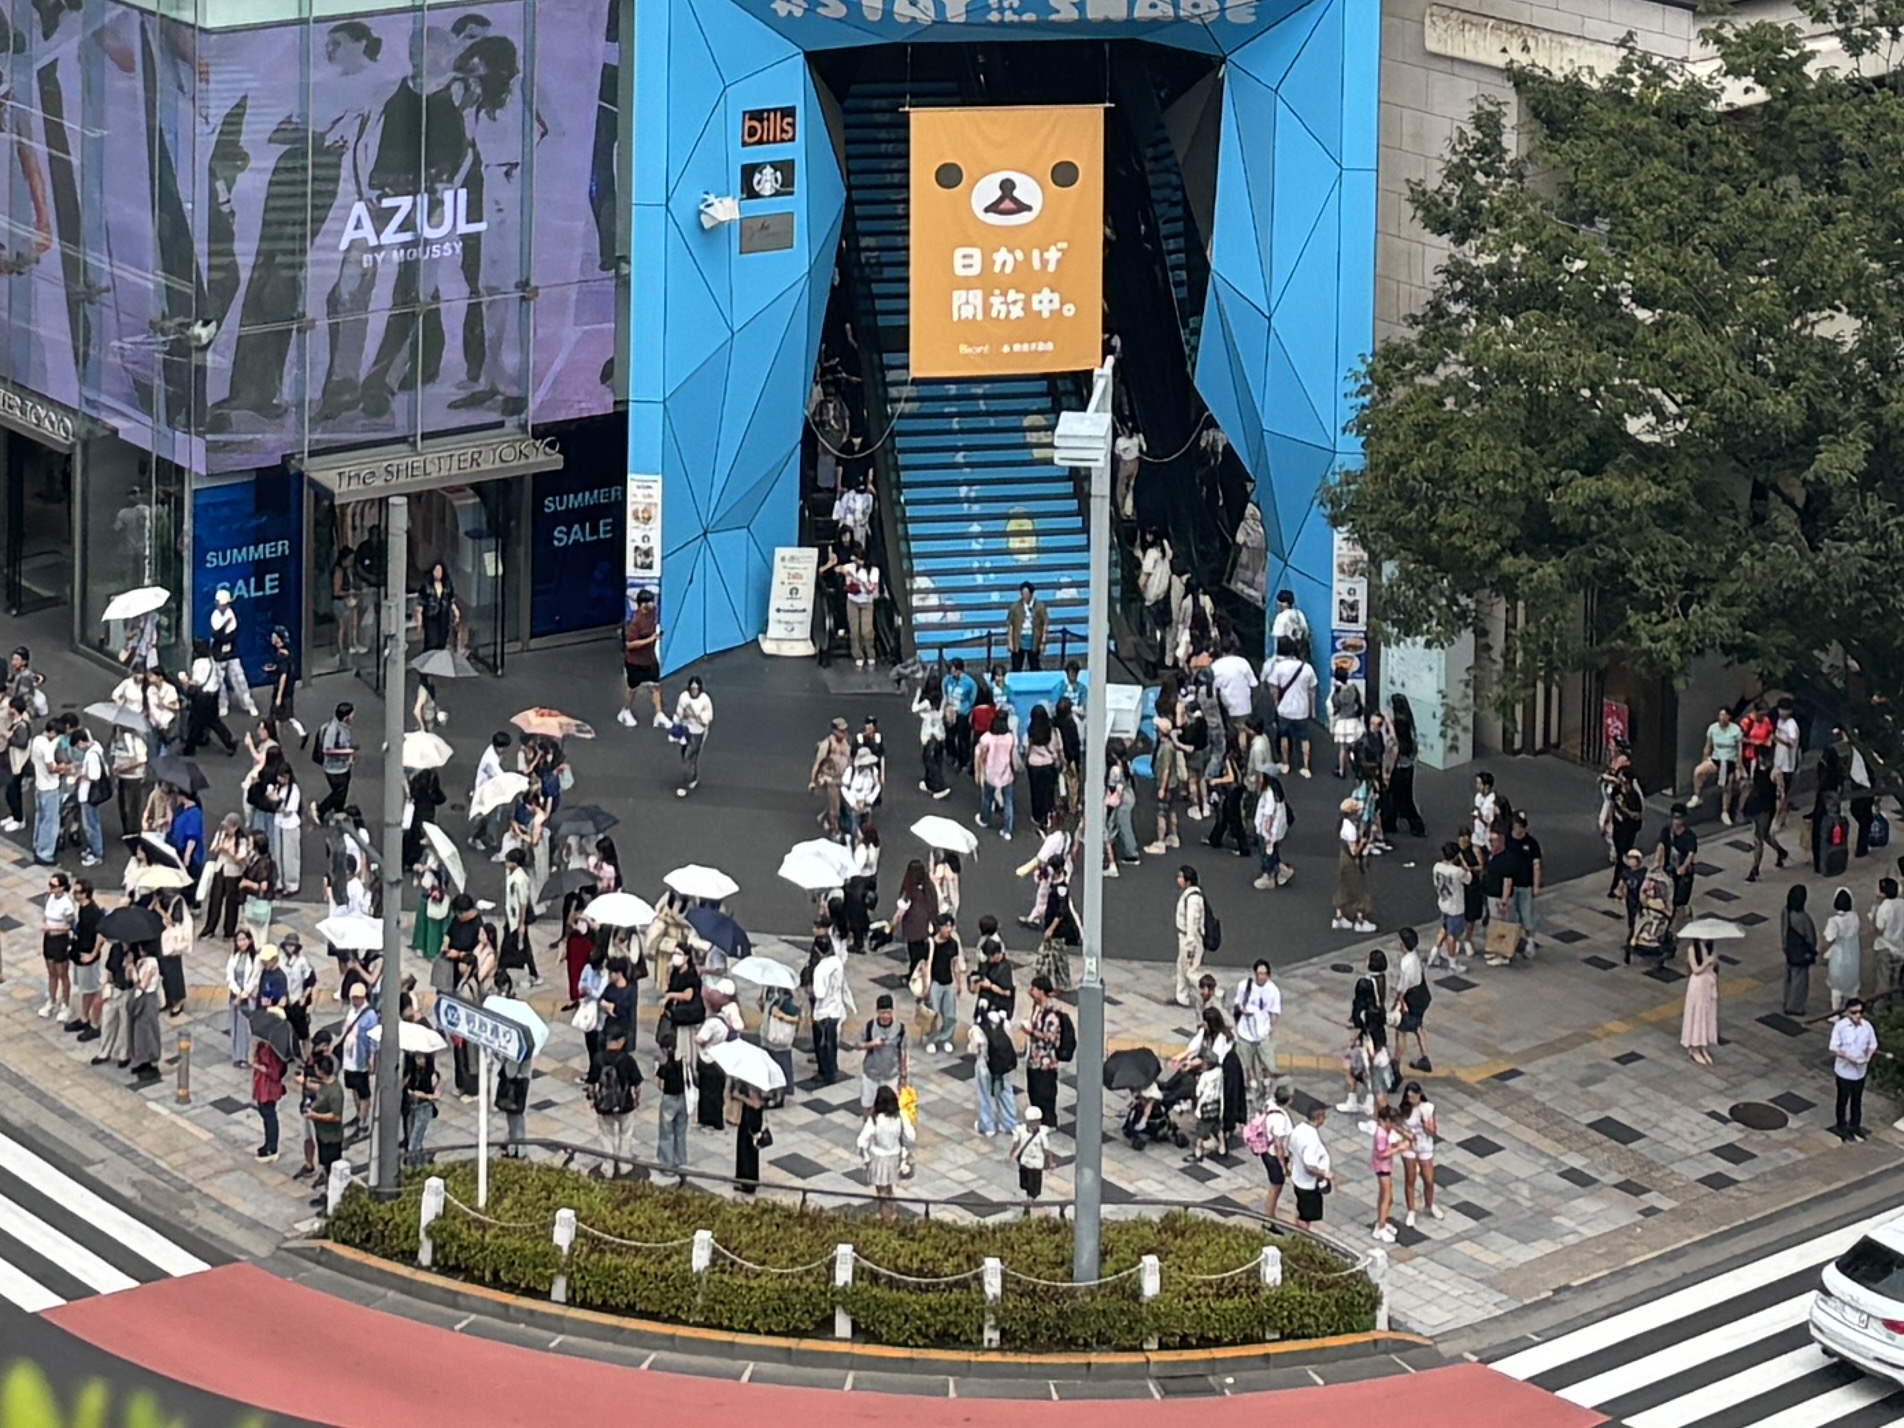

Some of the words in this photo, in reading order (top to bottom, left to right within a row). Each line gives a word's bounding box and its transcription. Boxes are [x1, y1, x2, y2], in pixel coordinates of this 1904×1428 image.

[744, 110, 794, 143] bills
[338, 188, 488, 251] AZUL
[362, 251, 386, 268] BY
[392, 241, 463, 263] MOUSSY
[953, 241, 1068, 276] 日かげ
[952, 287, 1076, 322] 開放中。
[336, 469, 377, 490] The
[490, 436, 560, 462] TOKYO
[543, 486, 624, 513] SUMMER
[553, 519, 614, 547] SALE
[206, 540, 290, 568] SUMMER
[218, 574, 280, 604] SALE
